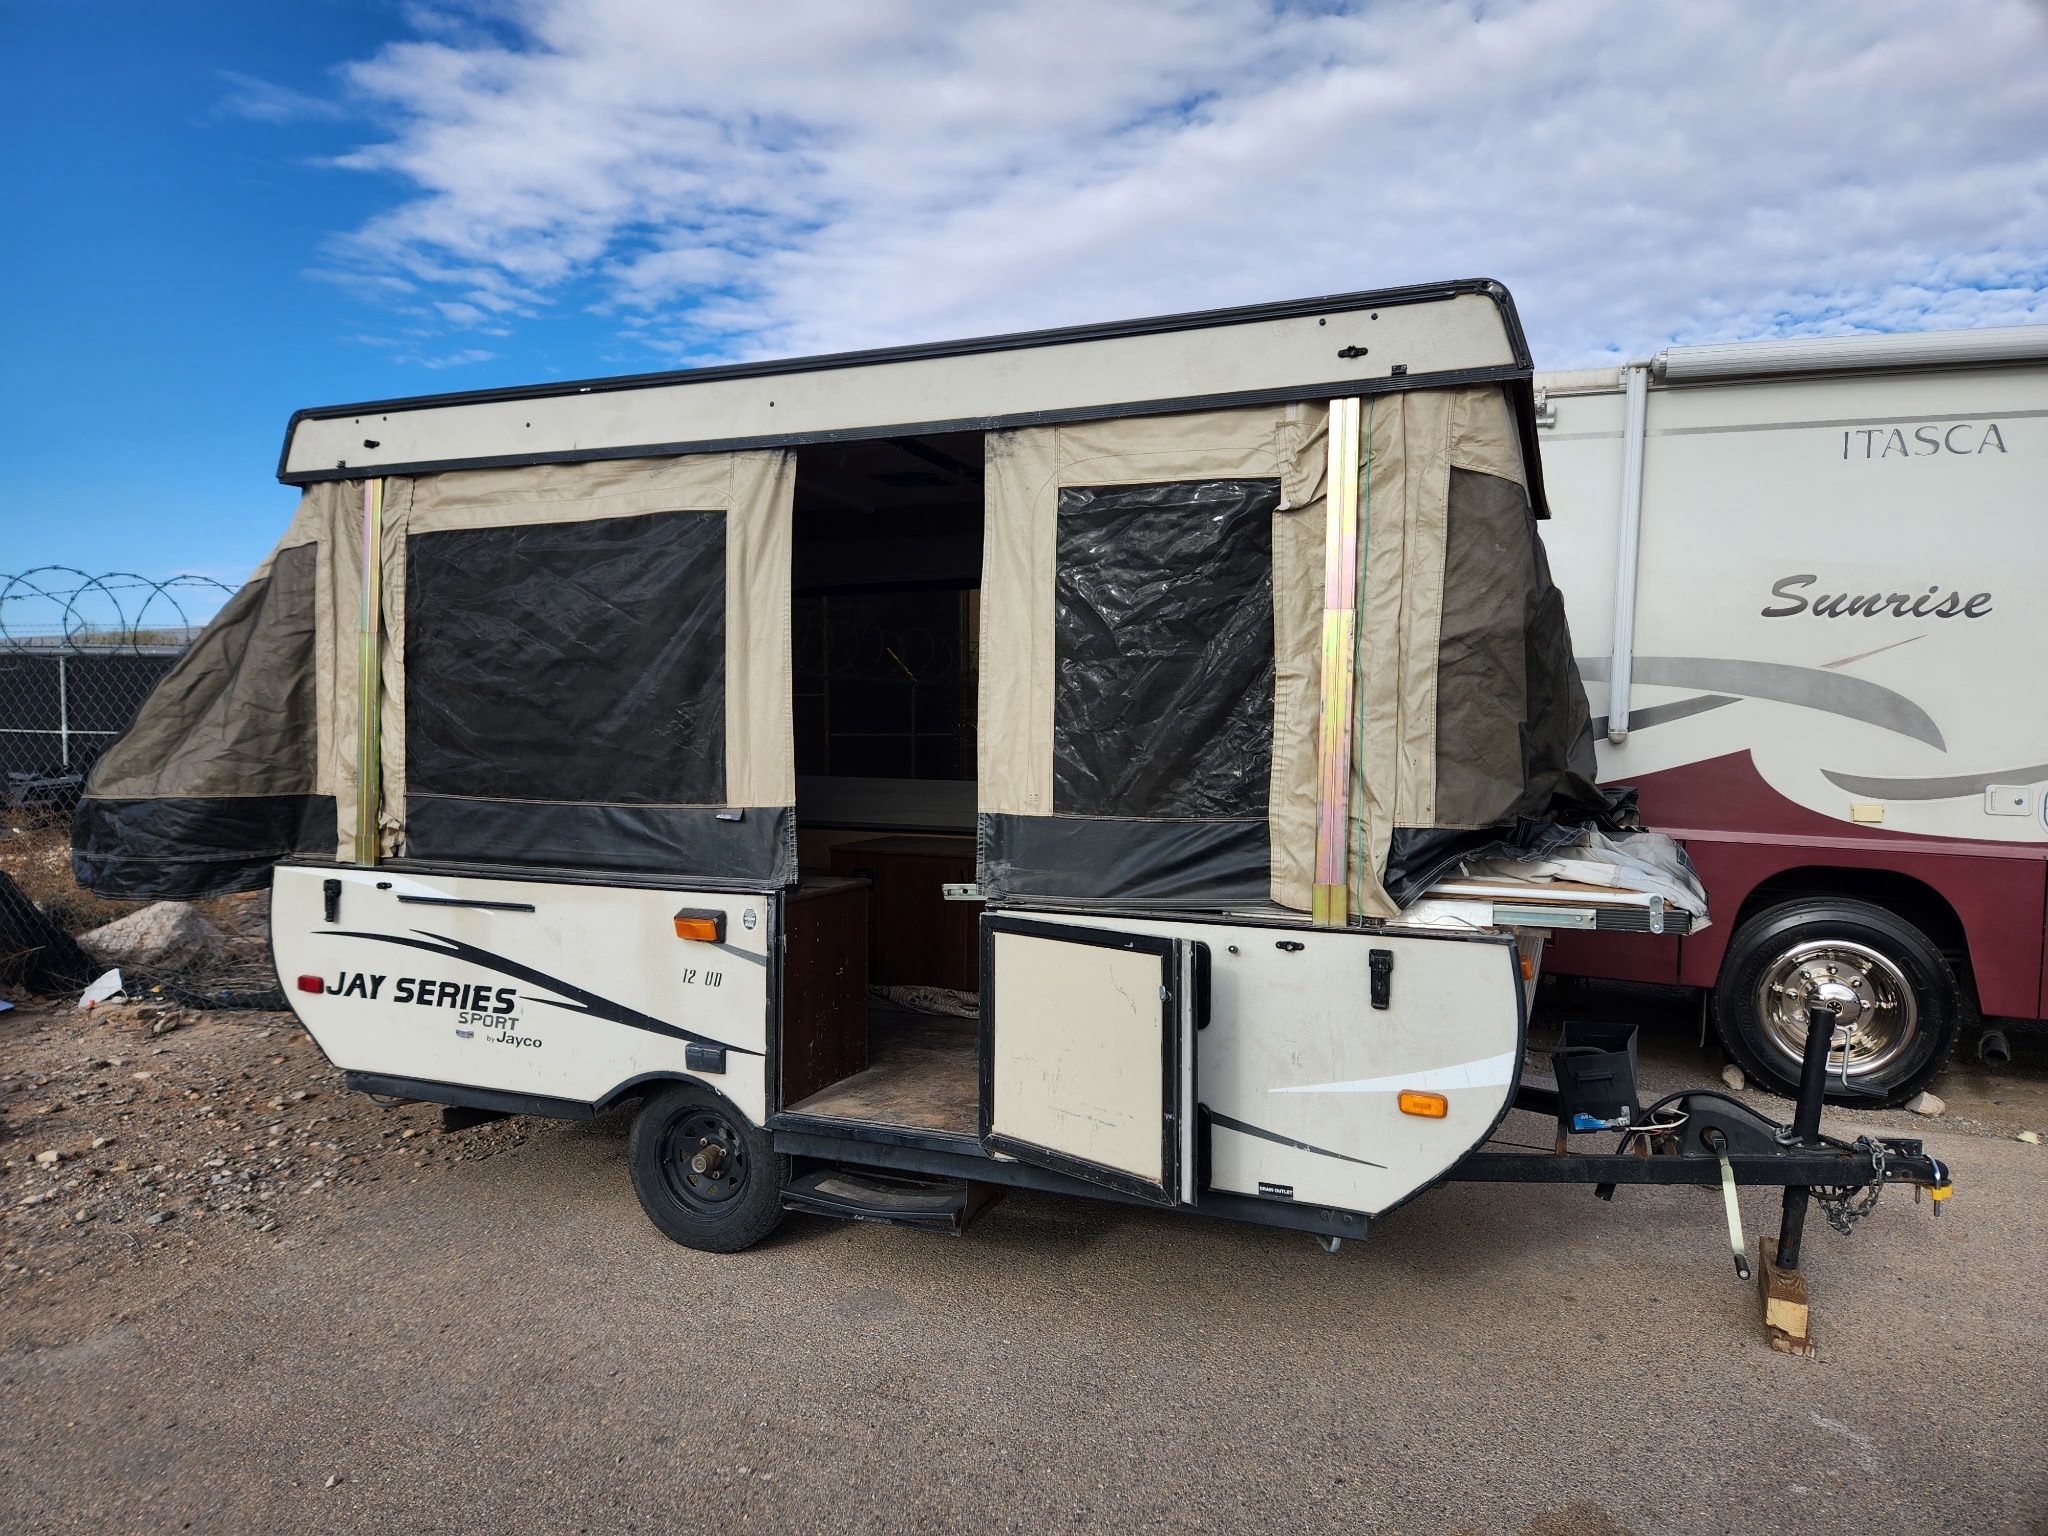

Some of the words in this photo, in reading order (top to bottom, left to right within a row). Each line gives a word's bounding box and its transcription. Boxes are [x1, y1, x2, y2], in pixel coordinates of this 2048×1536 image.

[1843, 423, 2008, 460] ITASCA
[1761, 574, 1993, 619] Sunrise
[682, 968, 697, 985] 12
[325, 971, 388, 1000] JAY
[393, 977, 517, 1015] SERIES
[457, 1011, 520, 1031] SPORT
[486, 1036, 496, 1044] by
[496, 1031, 543, 1048] Jayco
